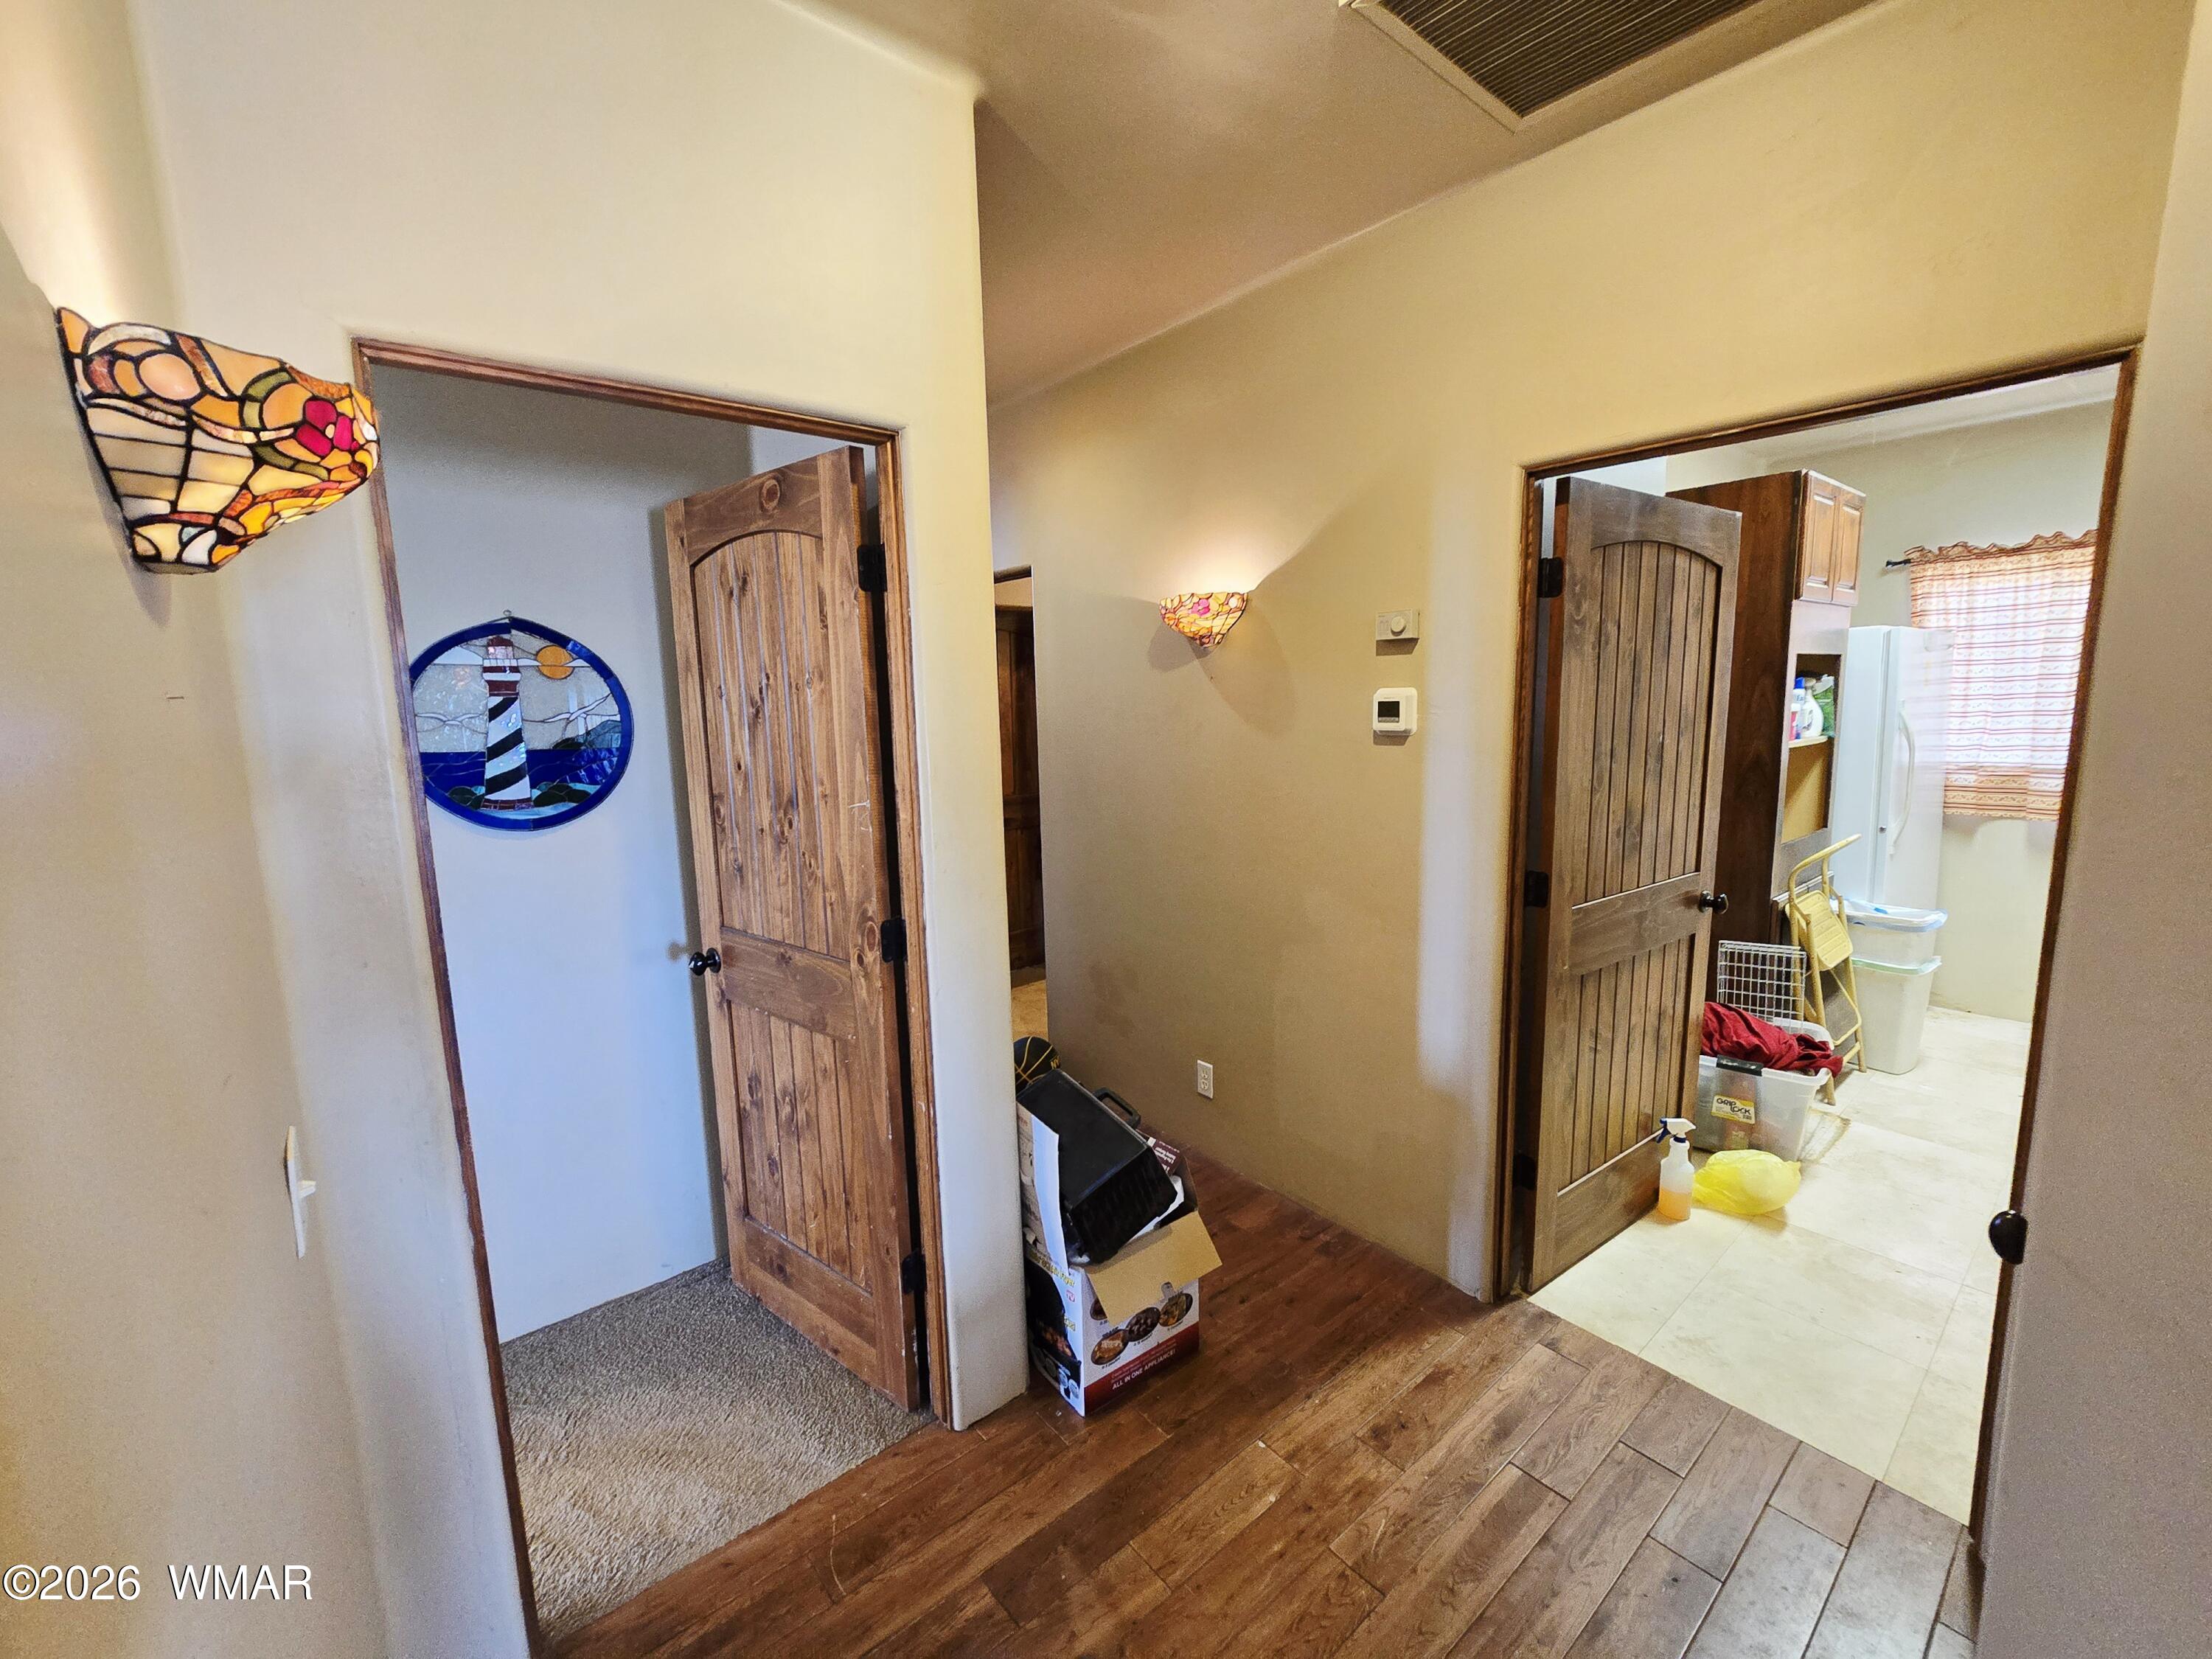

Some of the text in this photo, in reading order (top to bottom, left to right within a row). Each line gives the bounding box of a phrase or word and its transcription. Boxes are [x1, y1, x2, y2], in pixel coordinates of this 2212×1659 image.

[1717, 1098, 1736, 1106] GRIP
[1731, 1105, 1751, 1115] LOCK
[1112, 1349, 1176, 1390] ALL IN ONE APPLIANCE!
